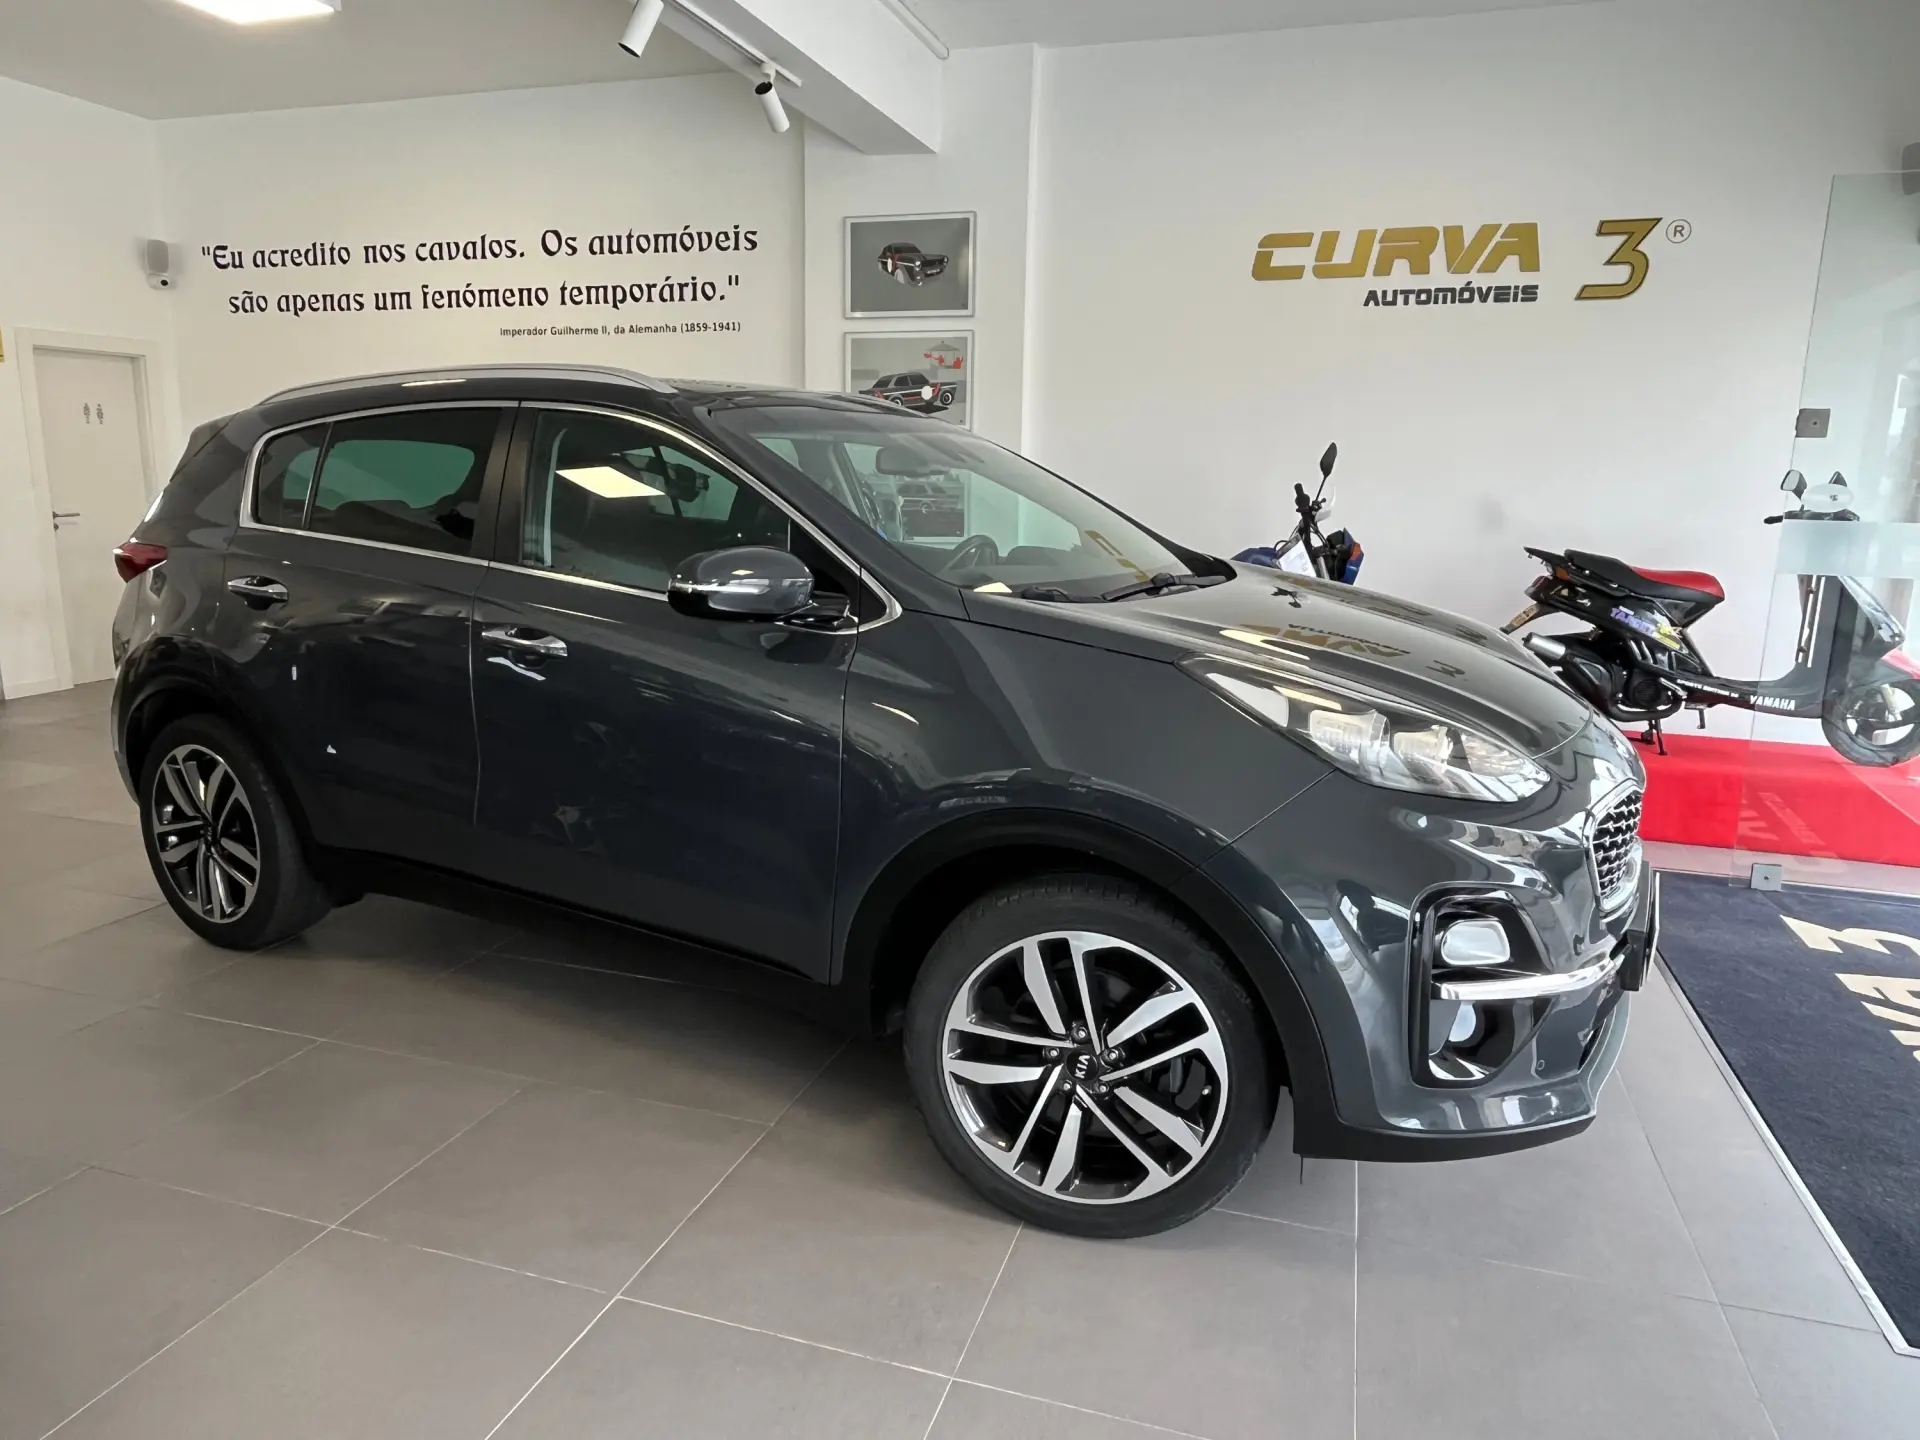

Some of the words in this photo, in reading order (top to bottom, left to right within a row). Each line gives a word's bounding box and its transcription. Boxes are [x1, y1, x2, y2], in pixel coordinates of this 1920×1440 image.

[202, 245, 244, 269] "Eu
[253, 242, 350, 268] acredito
[364, 244, 405, 263] nos
[416, 234, 524, 261] cavalos.
[541, 230, 577, 256] Os
[589, 225, 757, 255] automóveis
[1252, 222, 1541, 281] CURVA
[1574, 217, 1663, 301] 3
[229, 291, 268, 313] são
[277, 294, 364, 317] apenas
[374, 292, 412, 311] um
[422, 283, 548, 309] fenómeno
[560, 275, 738, 310] temporário."
[1363, 281, 1539, 307] AUTOMÓVEIS
[500, 326, 547, 338] Imperador
[550, 326, 599, 336] Guilherme
[613, 325, 626, 335] da
[628, 323, 677, 334] Alemanha
[680, 321, 741, 334] (1859-1941)
[1749, 695, 1796, 711] YAMAHA
[1074, 1054, 1091, 1079] KIA
